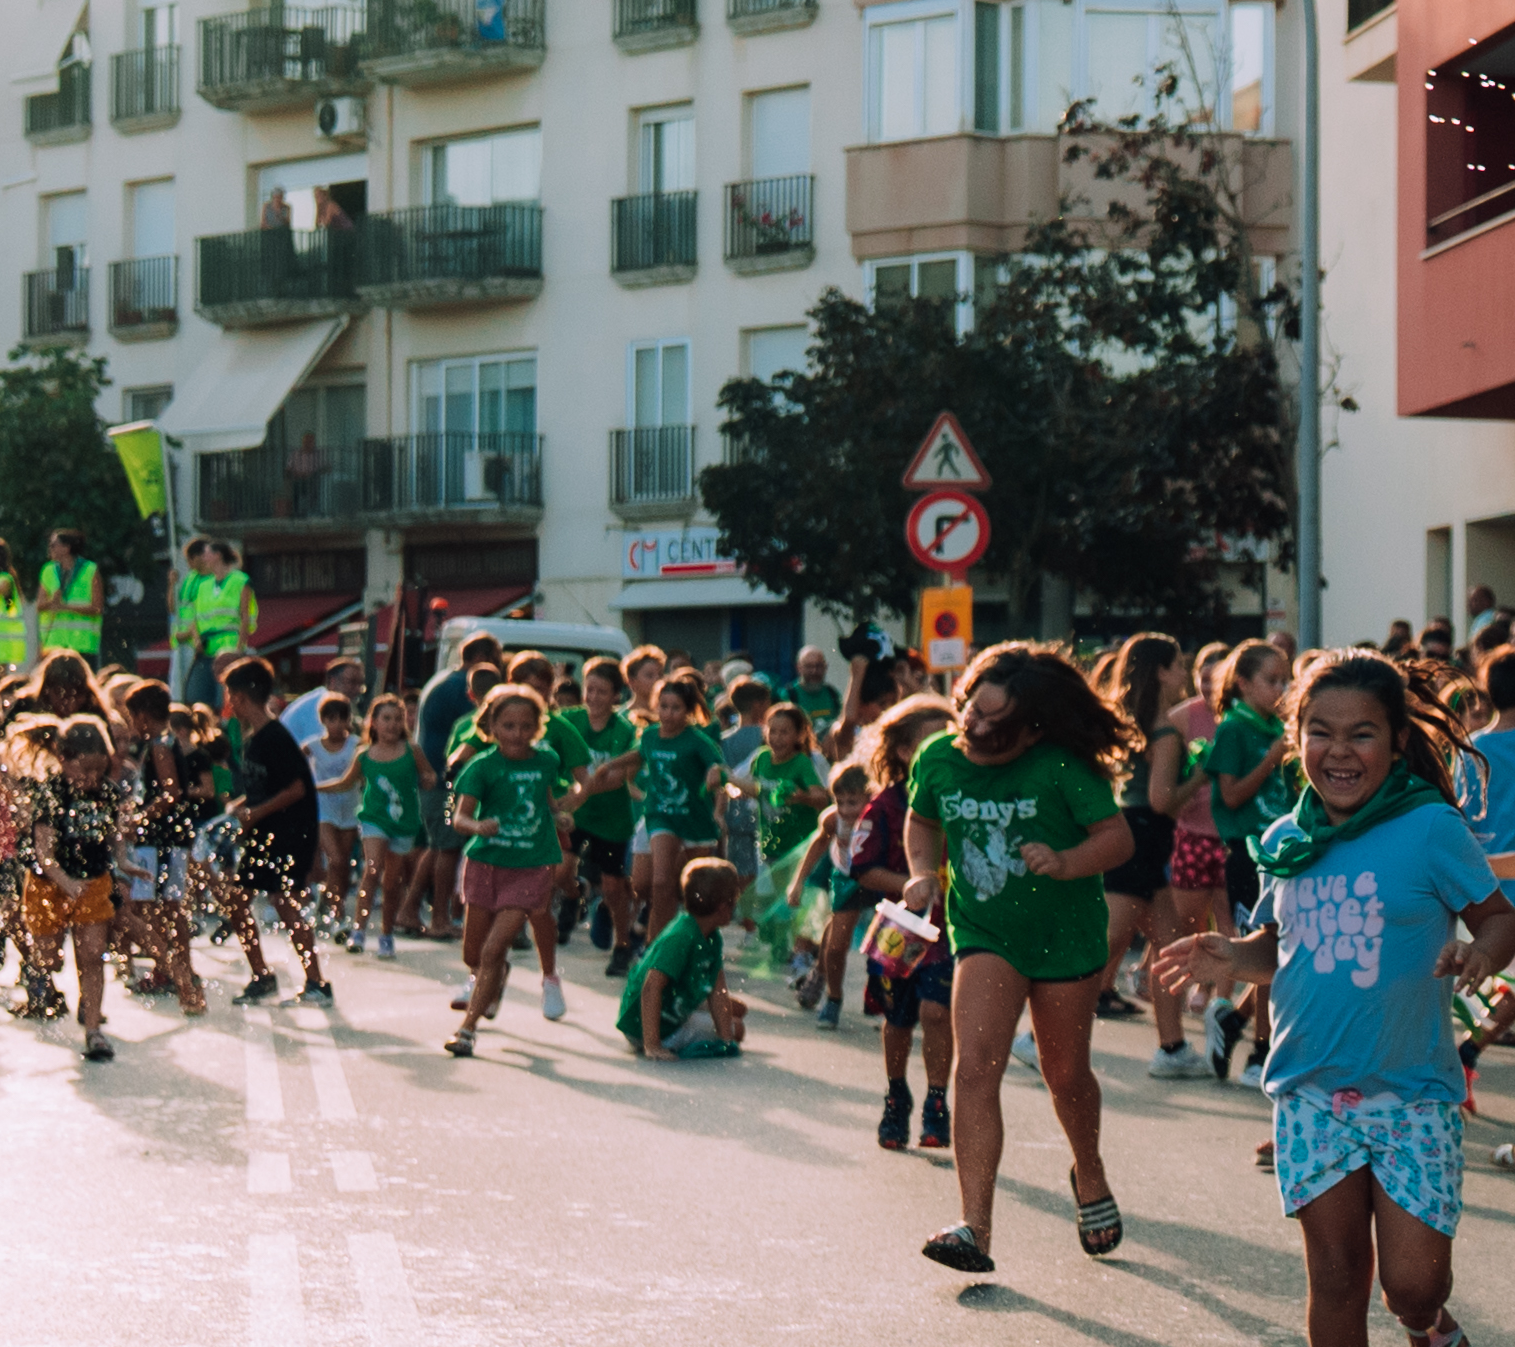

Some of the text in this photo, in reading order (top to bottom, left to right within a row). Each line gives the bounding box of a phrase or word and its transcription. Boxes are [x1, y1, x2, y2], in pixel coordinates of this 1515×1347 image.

[668, 535, 718, 563] CENT
[1353, 871, 1378, 897] a
[1313, 935, 1383, 989] day
